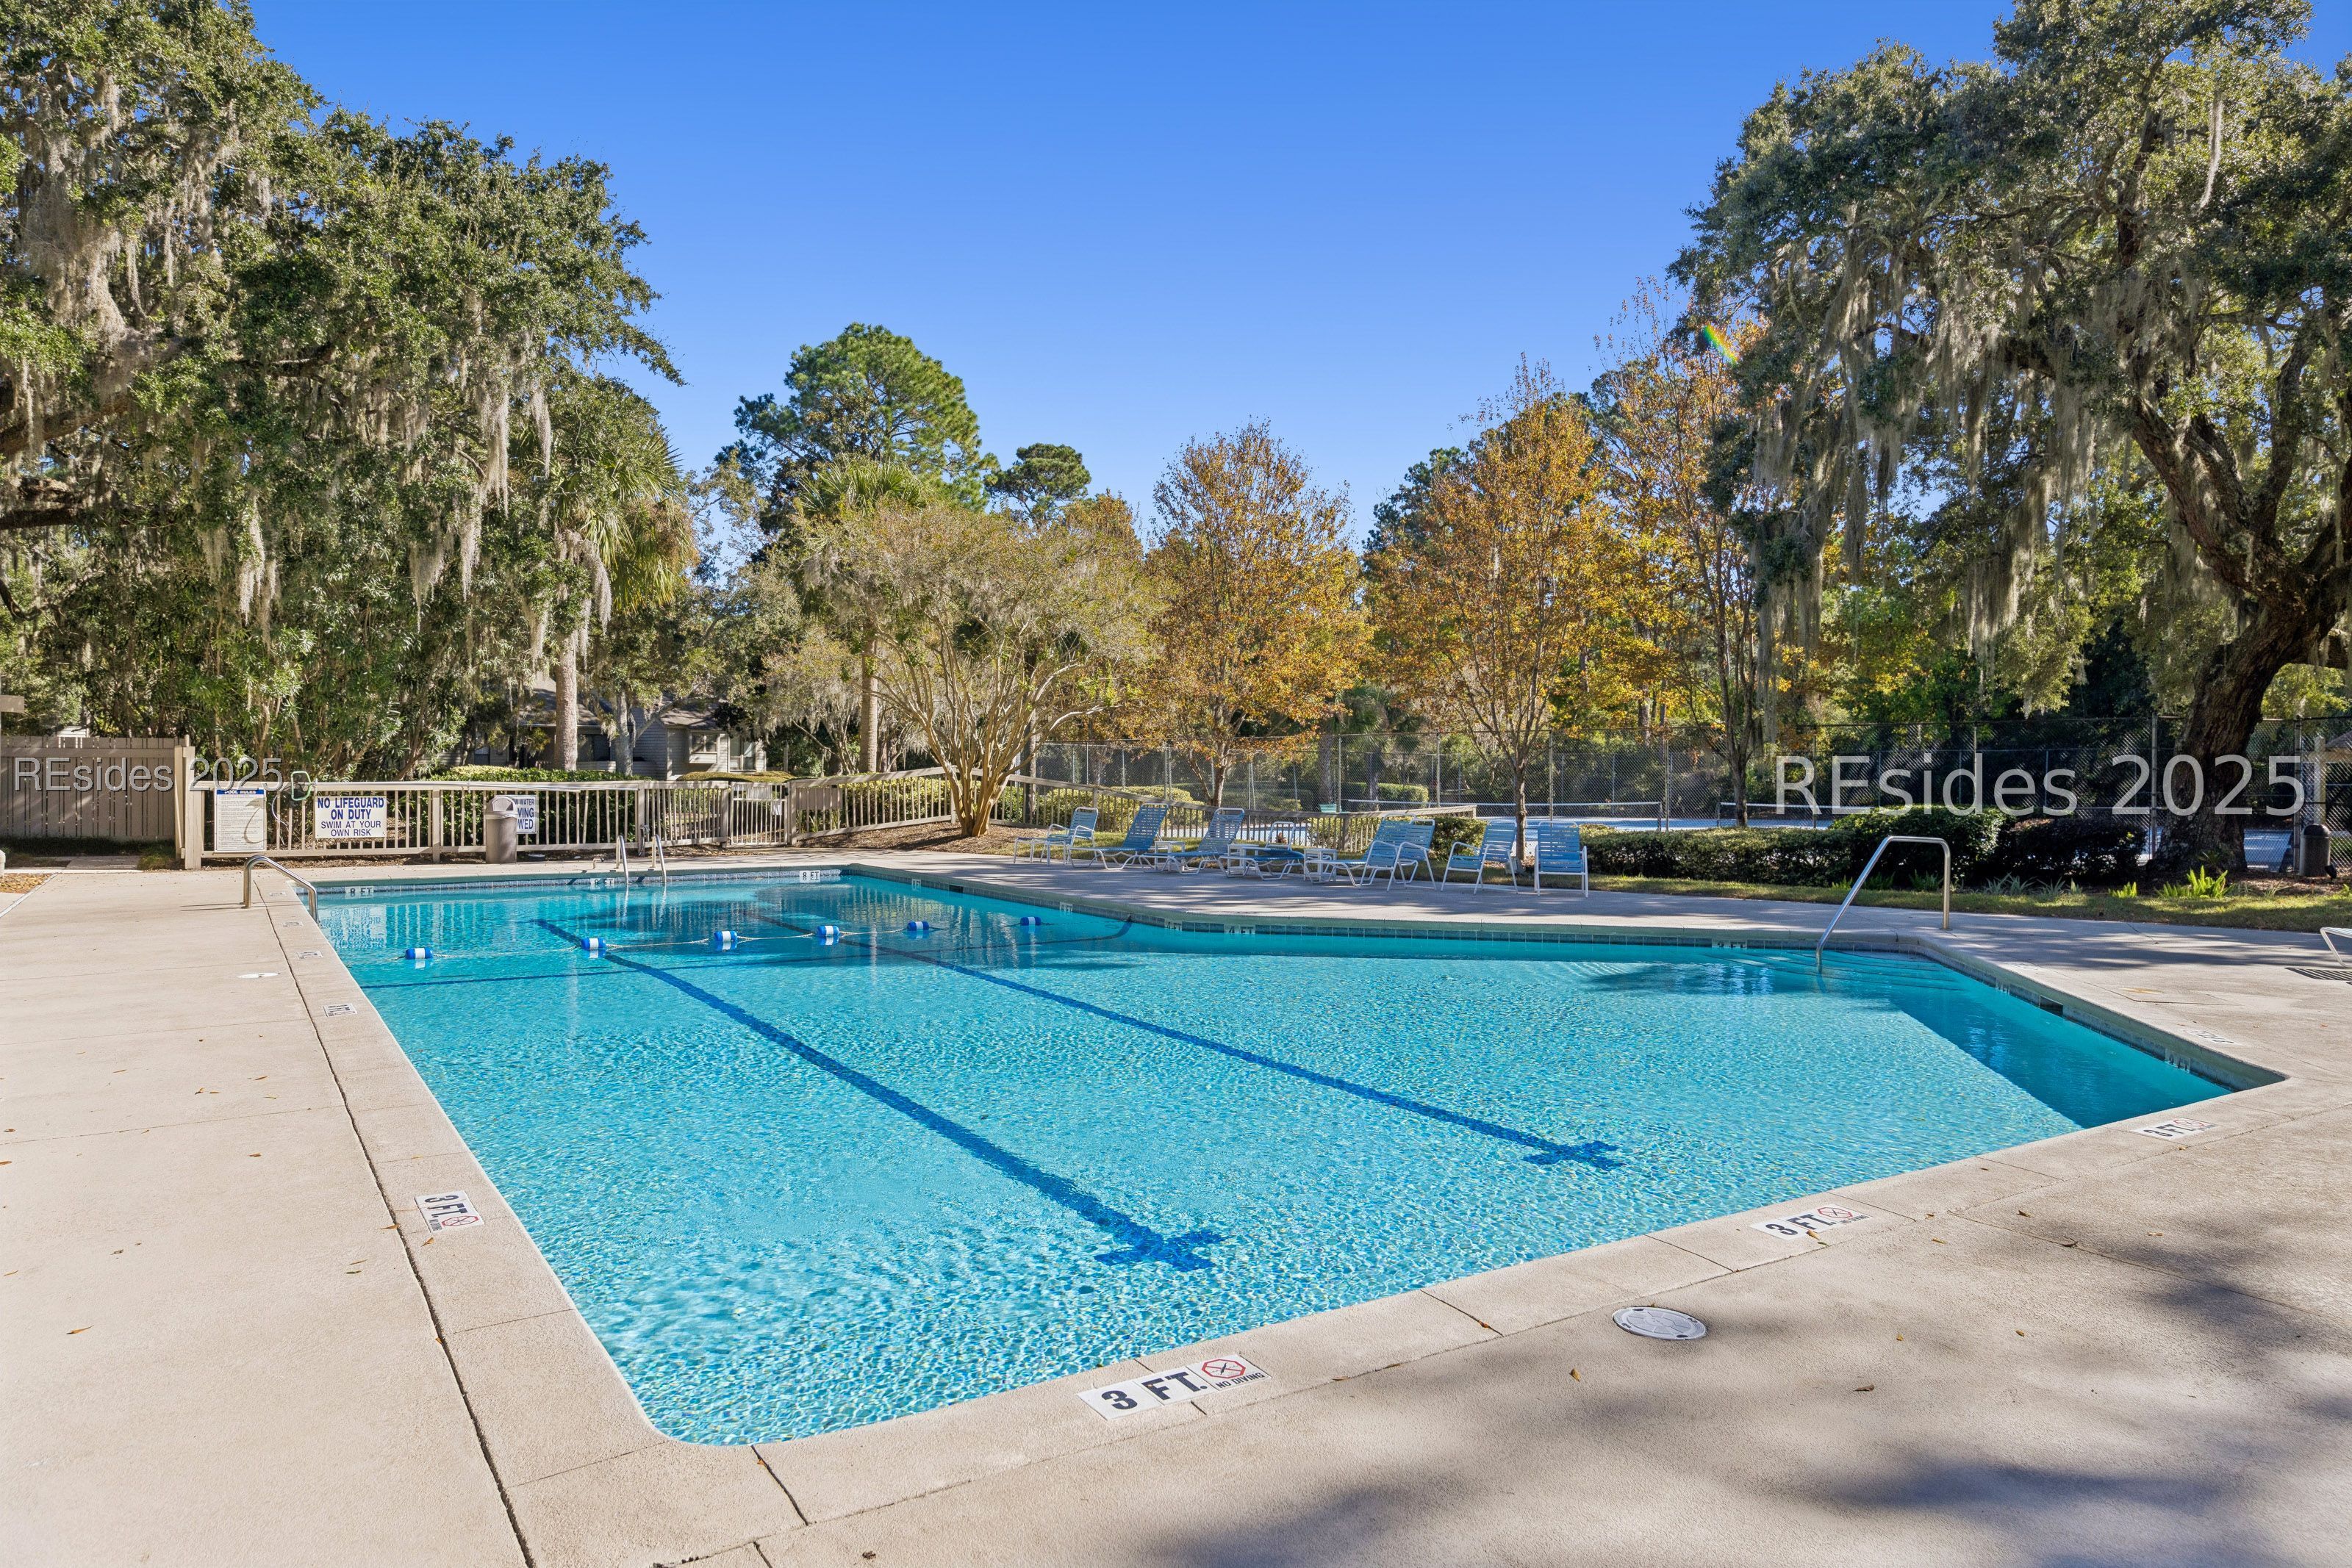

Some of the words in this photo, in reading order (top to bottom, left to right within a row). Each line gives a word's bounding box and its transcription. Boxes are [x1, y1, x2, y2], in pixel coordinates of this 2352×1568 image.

[318, 797, 330, 808] NO
[335, 797, 384, 808] LIFEGUARD
[331, 809, 343, 820] ON
[348, 809, 371, 819] DUTY
[517, 808, 534, 818] VING
[321, 821, 342, 829] SWIM
[359, 820, 381, 828] YOUR
[517, 819, 534, 829] WED
[2143, 1129, 2173, 1137] 3
[424, 1195, 459, 1203] 3
[1765, 1223, 1799, 1236] 3
[1215, 1381, 1233, 1389] NO
[1233, 1372, 1266, 1385] DIVING
[1101, 1390, 1138, 1410] 3
[1141, 1371, 1208, 1400] FT.
